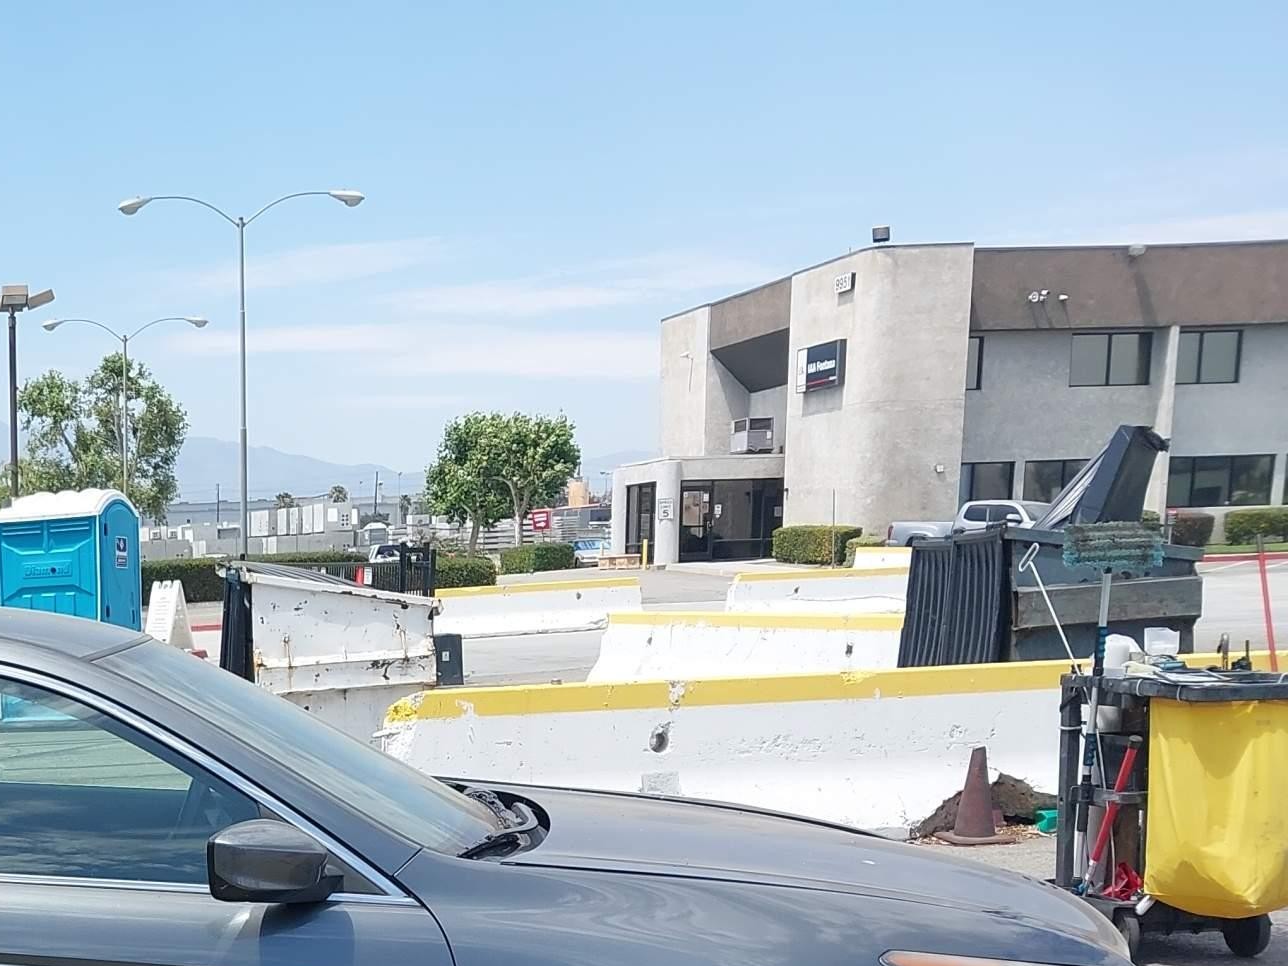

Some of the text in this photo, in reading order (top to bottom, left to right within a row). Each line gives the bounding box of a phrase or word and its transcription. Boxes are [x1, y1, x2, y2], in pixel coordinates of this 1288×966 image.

[835, 275, 851, 291] 9951
[662, 509, 670, 518] 5
[23, 562, 70, 577] Diamond
